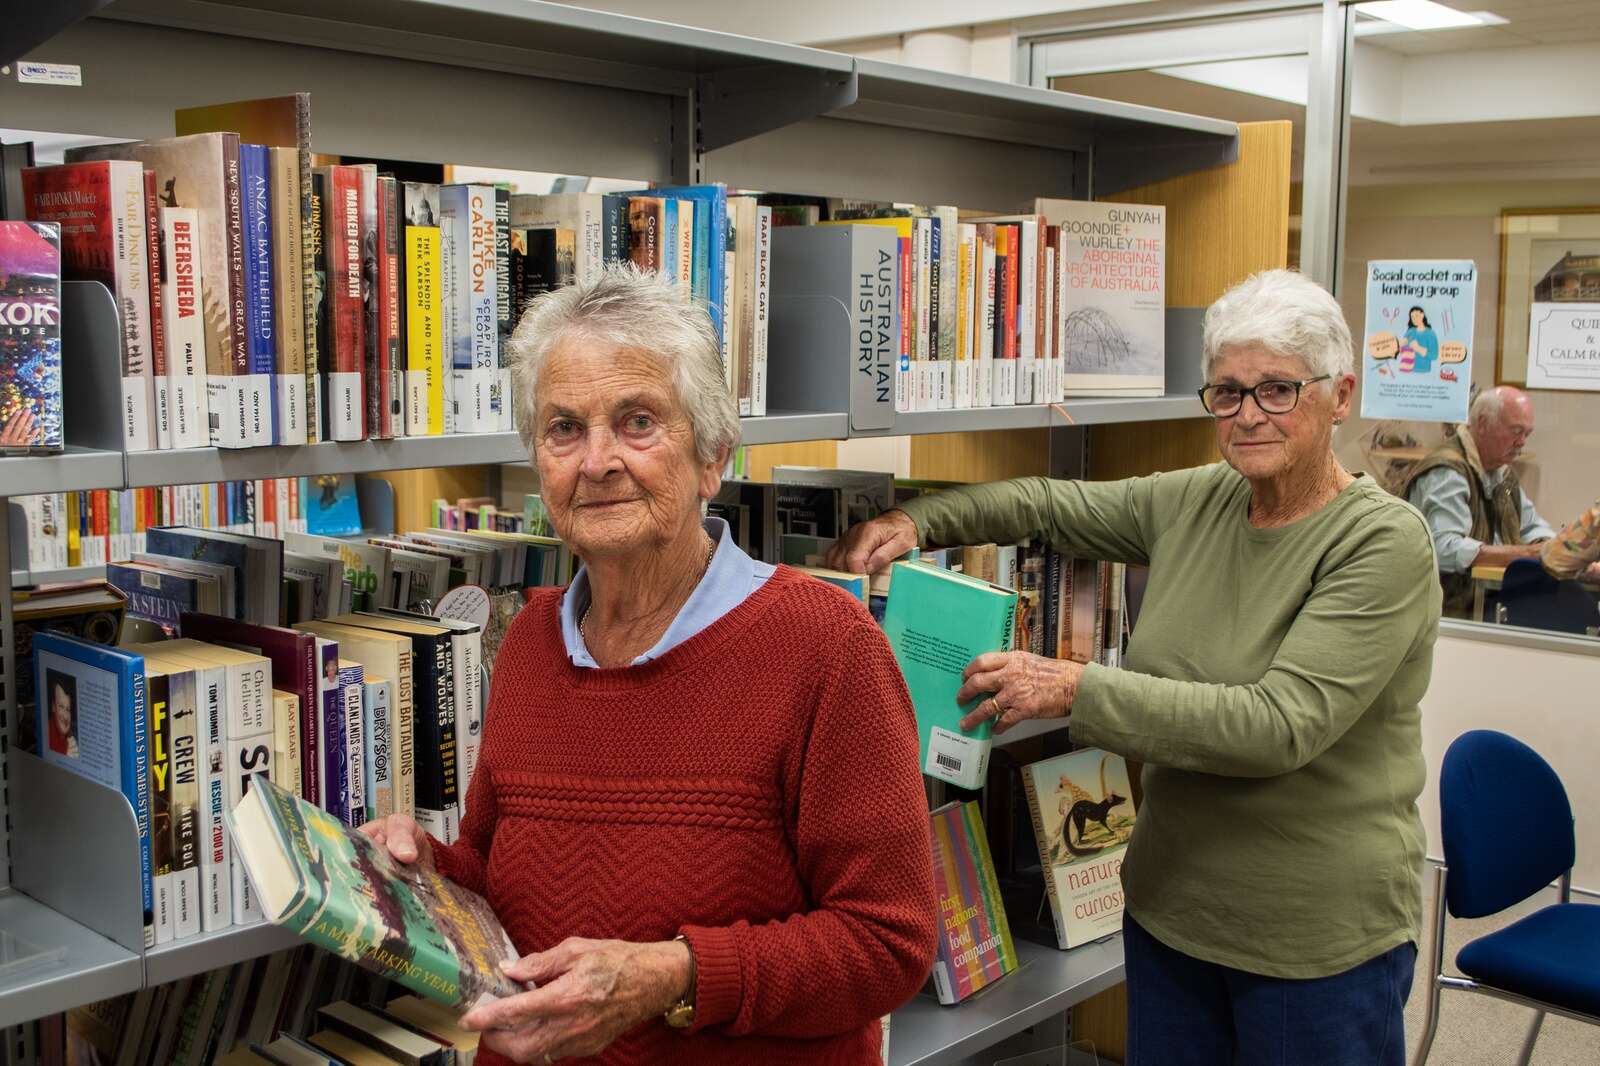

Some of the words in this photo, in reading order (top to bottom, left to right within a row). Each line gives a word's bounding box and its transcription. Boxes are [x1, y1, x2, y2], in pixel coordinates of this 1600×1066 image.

[229, 159, 239, 185] NEW
[126, 190, 141, 222] FAIR
[148, 194, 156, 212] THE
[230, 188, 240, 229] SOUTH
[255, 175, 268, 233] ANZAC
[345, 189, 359, 237] MARKED
[495, 200, 509, 223] THE
[611, 208, 619, 224] The
[1108, 209, 1161, 225] GUNYAH
[150, 216, 159, 269] GALLIPOLI
[496, 224, 510, 254] LAST
[585, 223, 593, 253] Father
[593, 222, 601, 240] The
[611, 225, 619, 262] DRESS
[760, 215, 768, 247] RAAF
[933, 225, 941, 255] First
[1061, 220, 1122, 237] GOONDIE
[1079, 235, 1134, 250] WURLEY
[1136, 239, 1160, 251] THE
[127, 224, 143, 290] DINKUMS
[232, 233, 242, 271] WALES
[347, 239, 360, 260] FOR
[423, 237, 431, 256] THE
[471, 196, 485, 293] CARLTON
[483, 220, 496, 271] MIKE
[592, 241, 601, 259] Boy
[682, 230, 690, 281] WRITING
[1083, 249, 1160, 265] ABORIGINAL
[173, 221, 196, 318] BEERSHEBA
[348, 263, 360, 298] DEATH
[389, 257, 398, 293] UNDER
[759, 250, 768, 288] BLACK
[988, 268, 997, 299] SAND
[1070, 277, 1089, 289] OF
[1091, 277, 1160, 292] AUSTRALIA
[1372, 268, 1403, 282] Social
[1406, 269, 1449, 282] crochet
[1451, 269, 1473, 282] and
[152, 272, 161, 307] LETTER
[258, 239, 272, 339] BATTLEFIELD
[496, 256, 510, 321] NAVIGATOR
[930, 258, 940, 322] Footprints
[1381, 284, 1425, 298] knitting
[1425, 285, 1459, 299] group
[235, 300, 245, 337] GREAT
[390, 297, 398, 336] ATTACK
[483, 298, 491, 341] SCRAP
[758, 292, 767, 321] CATS
[987, 303, 996, 331] TALK
[424, 316, 432, 338] AND
[475, 307, 484, 369] FLOTILLA
[858, 273, 874, 377] HISTORY
[875, 249, 892, 403] AUSTRALIAN
[185, 343, 193, 365] PAUL
[238, 341, 246, 367] WAR
[1550, 348, 1585, 360] CALM
[1008, 558, 1017, 588] Ochre
[1050, 554, 1060, 596] Political
[1064, 570, 1073, 596] COWRA
[1050, 598, 1060, 625] Lives
[1063, 597, 1072, 634] BREAKOUT
[1000, 604, 1016, 653] THOMAS
[306, 658, 314, 684] MAJESTY
[399, 649, 411, 673] THE
[436, 643, 446, 669] AND
[445, 651, 453, 678] GAME
[400, 676, 412, 704] LOST
[446, 680, 454, 693] OF
[473, 663, 481, 690] NEIL
[208, 683, 218, 704] TOM
[241, 672, 252, 727] Helliwell
[254, 669, 265, 728] Christine
[437, 675, 448, 726] WOLVES
[133, 672, 146, 753] AUSTRALIA'S
[209, 705, 219, 745] TRUMBLE
[287, 703, 296, 723] RAY
[347, 694, 361, 746] CLANLANDS
[447, 696, 455, 724] BIRDS
[152, 701, 169, 792] FLY
[288, 725, 297, 760] MEARS
[326, 711, 339, 754] QUEEN
[373, 706, 388, 783] BRYSON
[400, 706, 413, 777] BATTALIONS
[439, 740, 456, 751] SECRET
[174, 735, 196, 784] CREW
[352, 757, 363, 795] ALMANAC
[136, 756, 149, 839] DAMBUSTERS
[211, 779, 223, 816] RESCUE
[181, 806, 193, 839] MIKE
[213, 816, 222, 825] AT
[212, 825, 224, 848] 2100
[142, 845, 150, 871] COLIN
[182, 843, 194, 867] COL
[1067, 857, 1122, 891] natura
[142, 872, 152, 912] BURGESS
[939, 893, 961, 913] first
[316, 921, 328, 935] A
[944, 904, 978, 930] nations
[949, 926, 972, 951] food
[953, 933, 1003, 968] companion
[421, 969, 457, 996] YEAR
